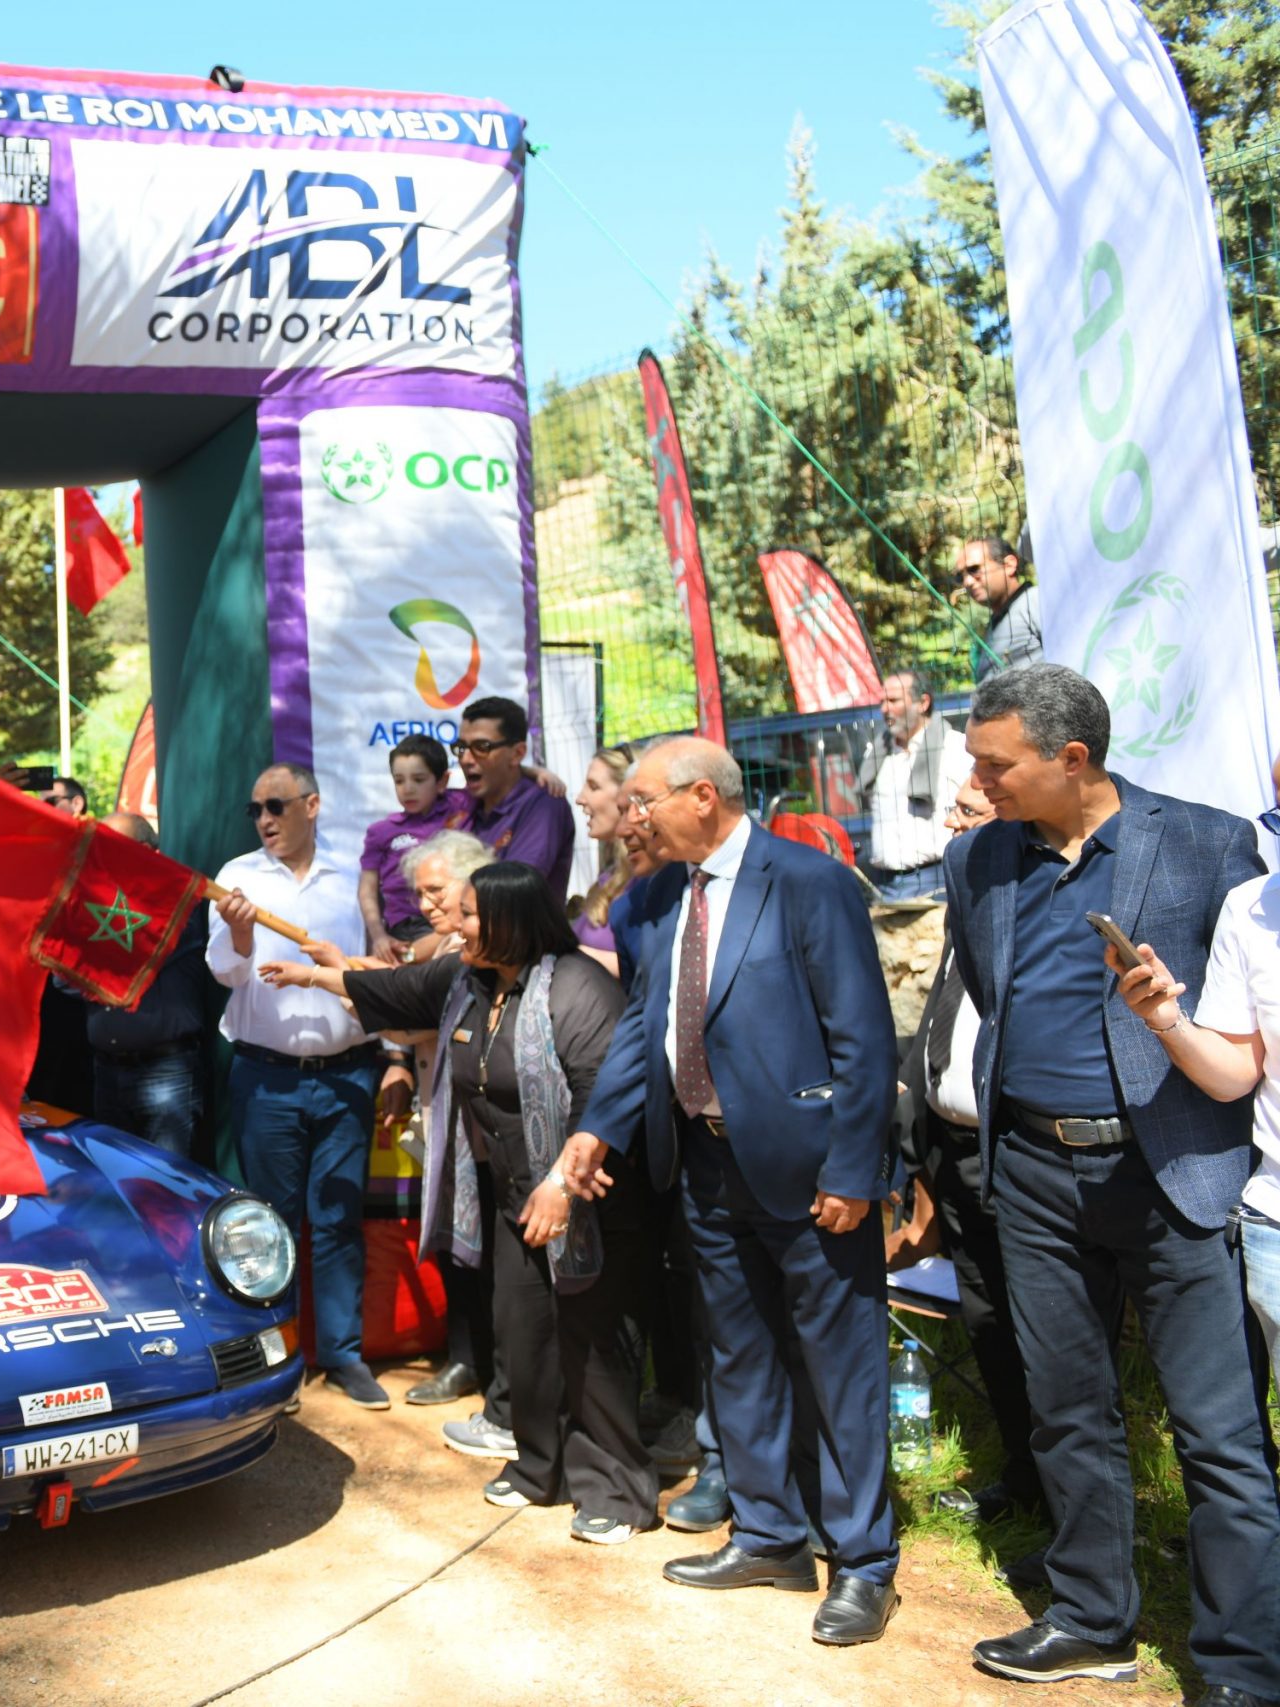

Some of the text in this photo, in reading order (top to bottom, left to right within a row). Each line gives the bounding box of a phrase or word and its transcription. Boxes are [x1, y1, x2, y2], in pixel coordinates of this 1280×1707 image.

[15, 92, 75, 124] LE
[81, 97, 169, 130] ROI
[175, 101, 461, 141] MOHAMMED
[461, 112, 509, 150] VI
[157, 168, 472, 306] ABL
[147, 310, 475, 346] CORPORATION
[405, 452, 510, 493] OCP
[21, 1271, 35, 1285] 1
[32, 1301, 74, 1315] RALLY
[25, 1430, 130, 1471] WW-241-CX
